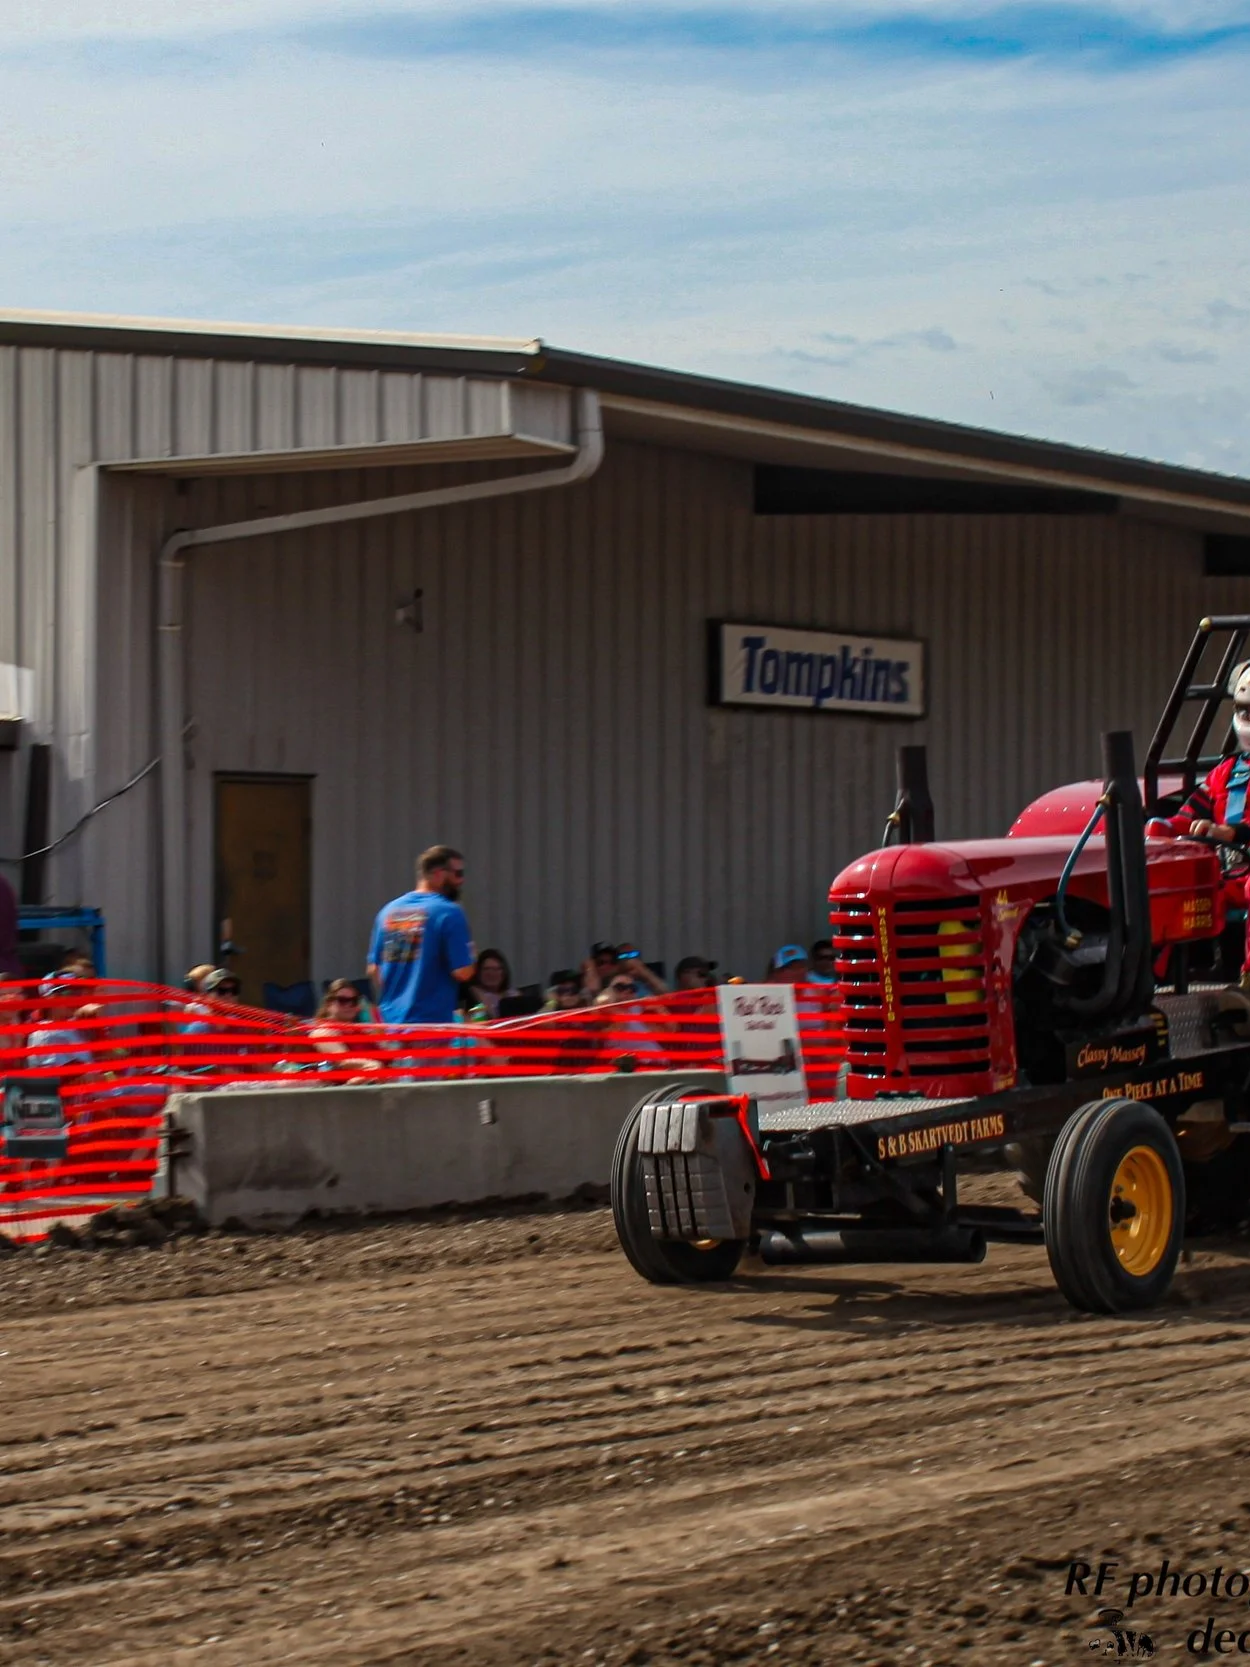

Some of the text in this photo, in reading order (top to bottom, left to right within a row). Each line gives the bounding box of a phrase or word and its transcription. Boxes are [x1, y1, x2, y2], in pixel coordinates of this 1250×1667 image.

[740, 635, 911, 707] Tompkins
[1077, 1043, 1146, 1069] Classy Massey
[877, 1114, 1005, 1160] S & B SKARTVEDT FARMS
